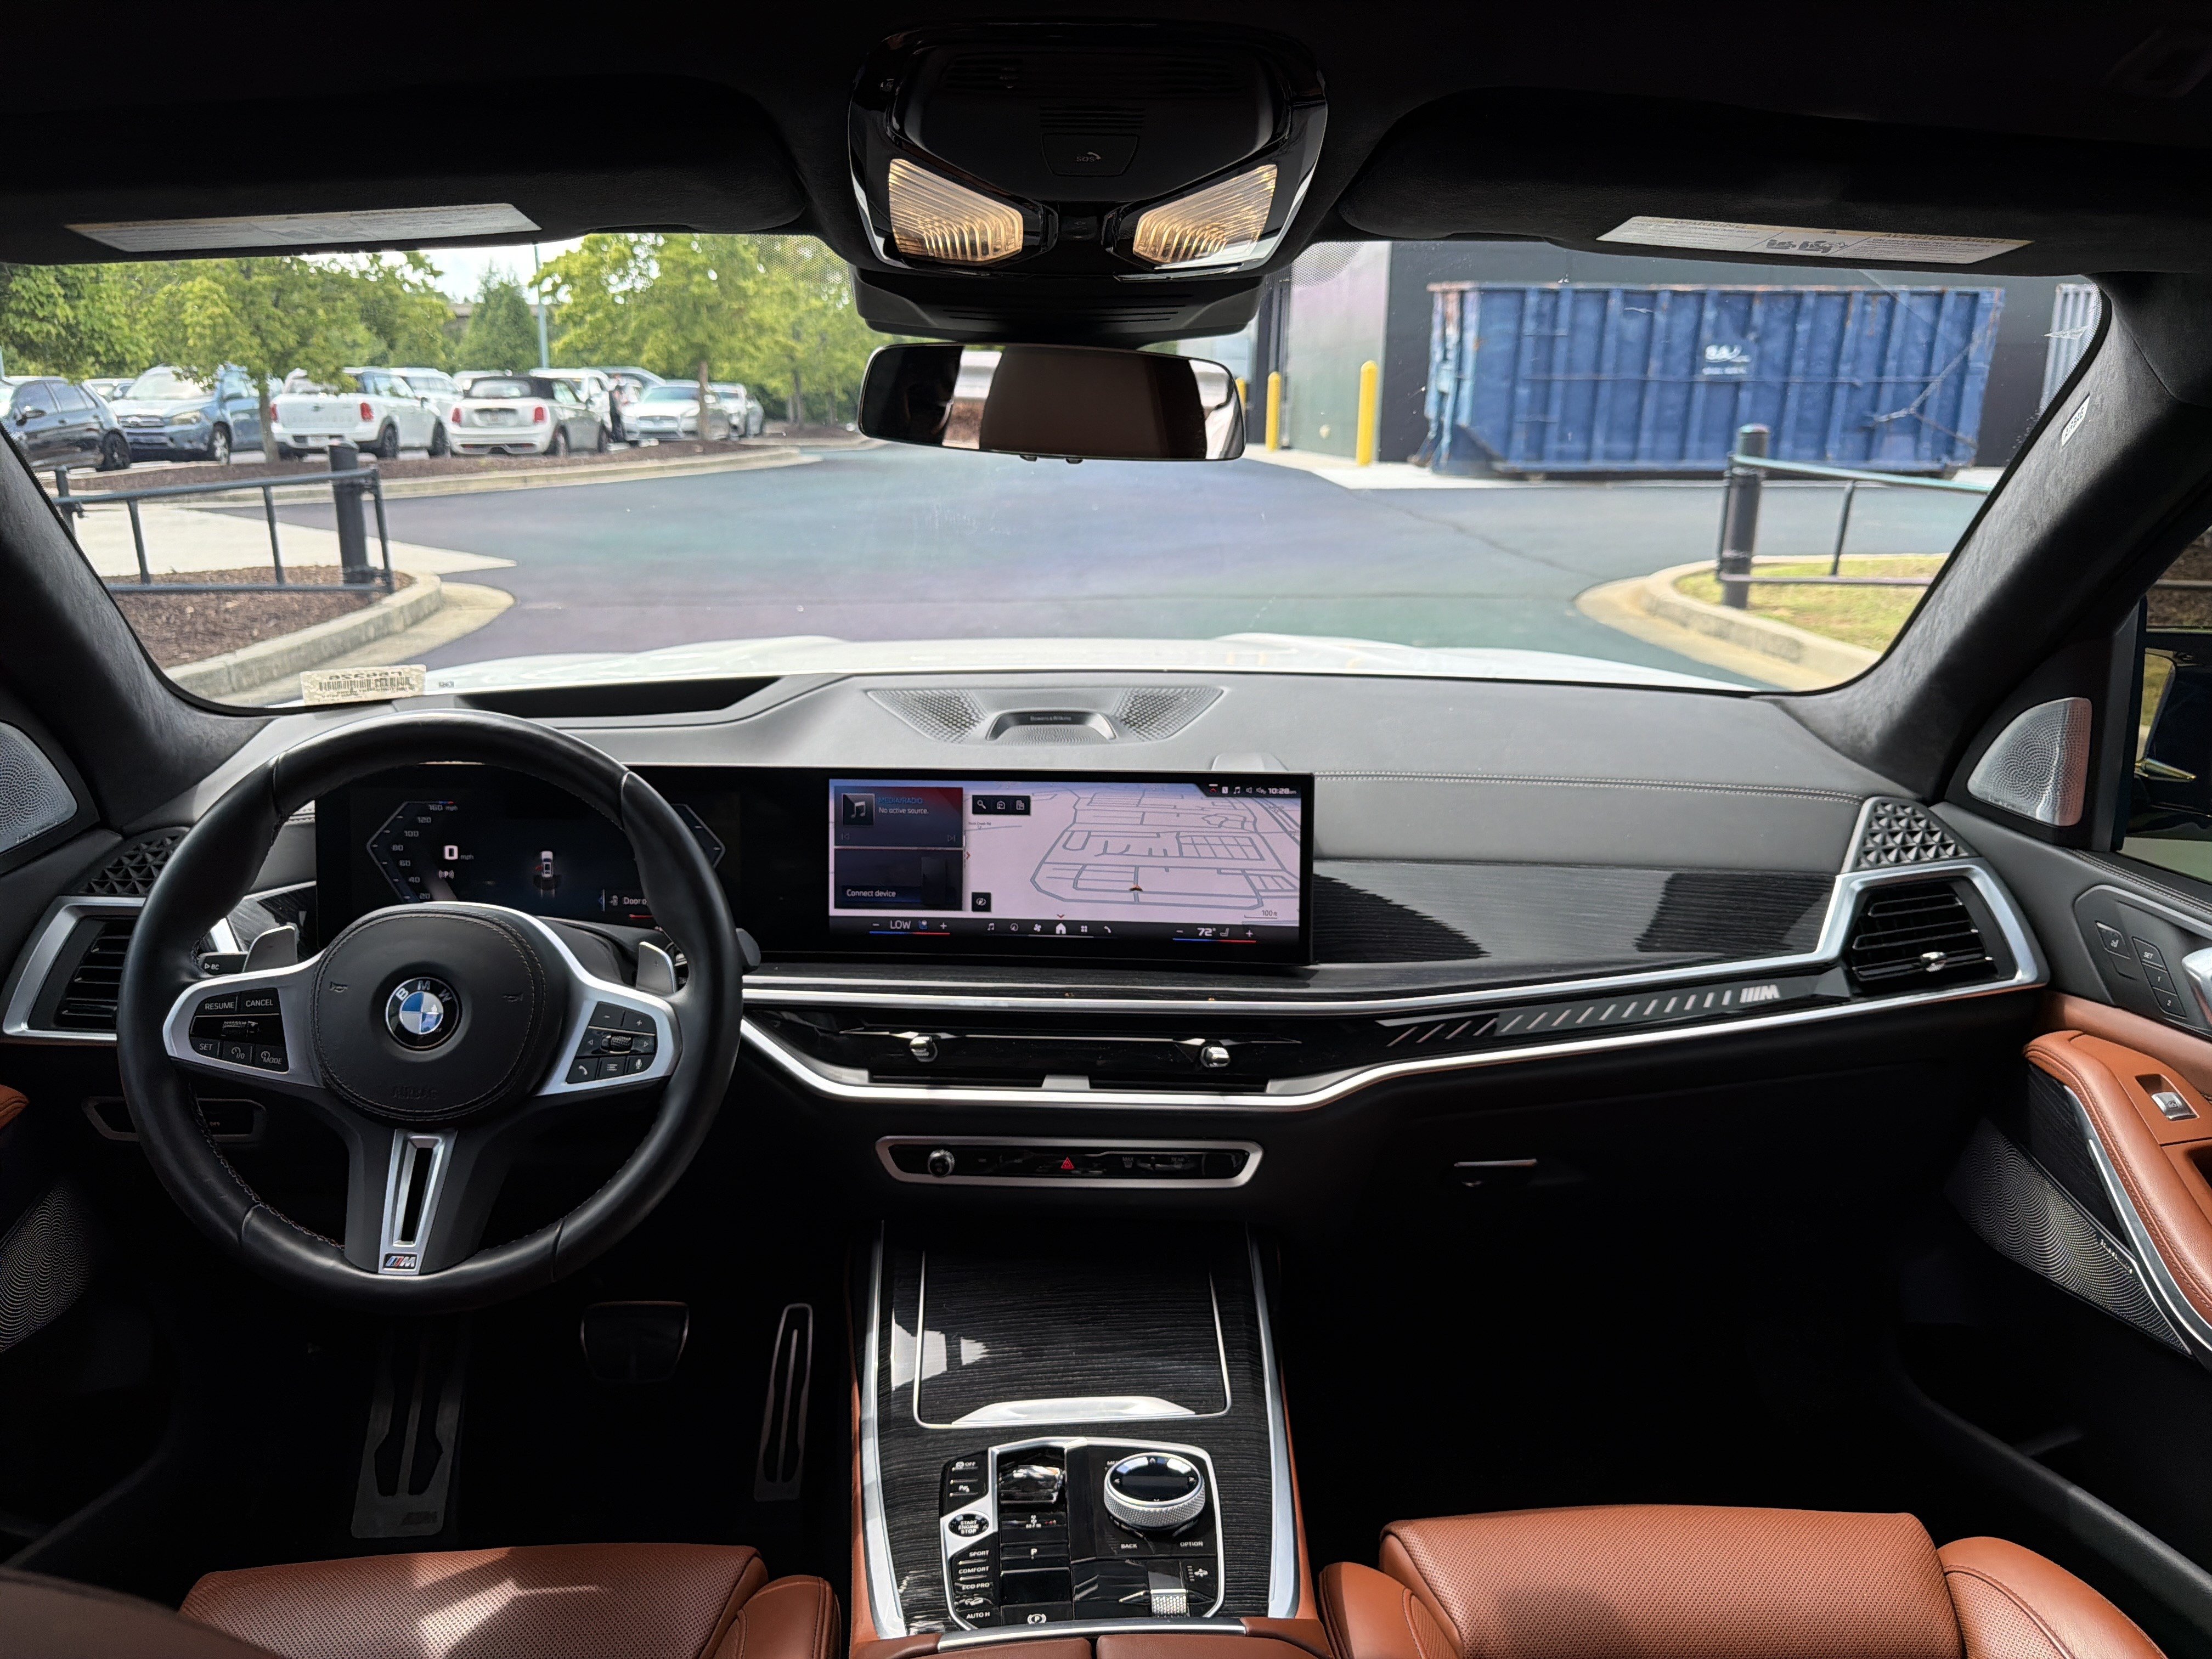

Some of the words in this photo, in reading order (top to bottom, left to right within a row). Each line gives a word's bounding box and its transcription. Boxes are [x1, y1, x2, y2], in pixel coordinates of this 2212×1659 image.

[444, 845, 459, 860] 0
[846, 889, 874, 897] Connect
[623, 896, 641, 905] Door
[890, 920, 911, 929] LOW
[205, 1002, 235, 1011] RESUME
[245, 999, 274, 1007] CANCEL
[958, 1566, 990, 1575] COMFORT
